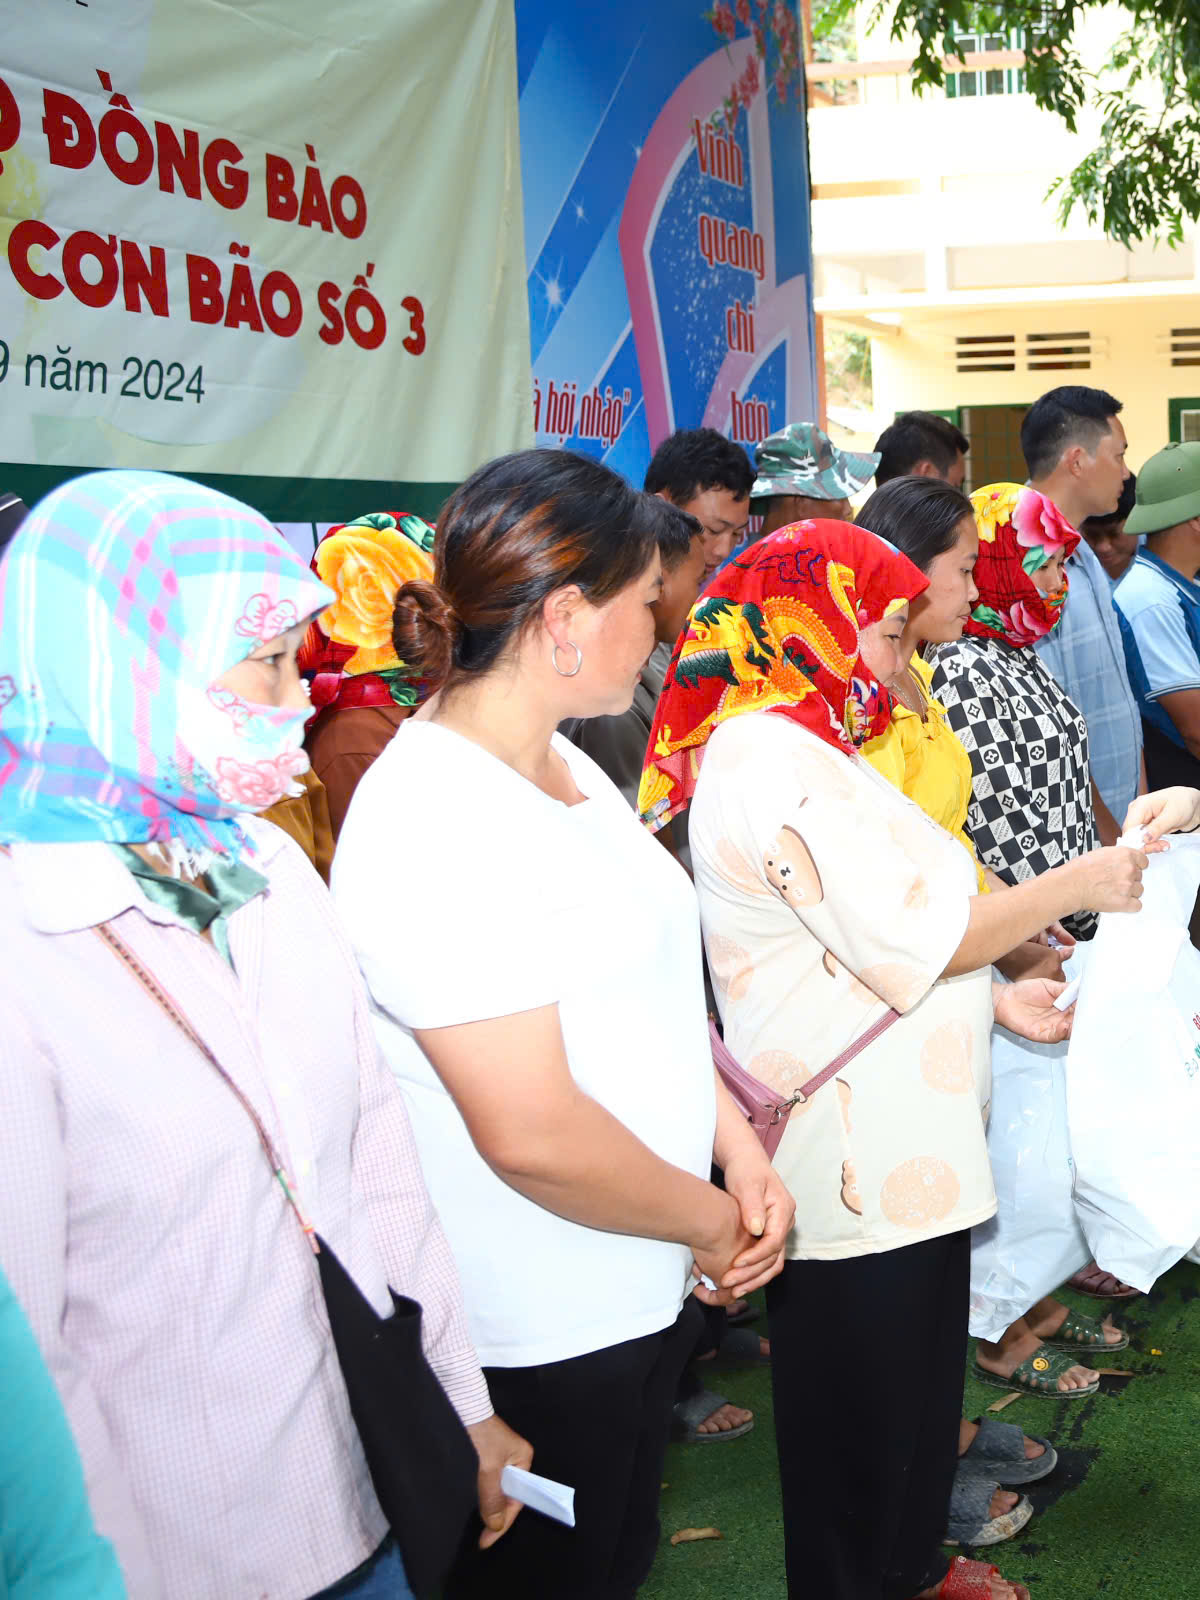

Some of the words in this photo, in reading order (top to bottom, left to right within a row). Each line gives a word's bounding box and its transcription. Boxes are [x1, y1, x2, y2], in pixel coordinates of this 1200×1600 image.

[41, 68, 249, 211] ĐỒNG
[265, 143, 367, 241] BÀO
[700, 215, 766, 281] quang
[7, 219, 170, 319] CƠN
[186, 241, 304, 339] BÃO
[316, 262, 388, 351] SỐ
[400, 295, 427, 357] 3
[726, 300, 755, 353] chi
[24, 344, 108, 395] năm
[119, 355, 206, 404] 2024
[545, 380, 577, 443] hội
[730, 390, 769, 443] hơn
